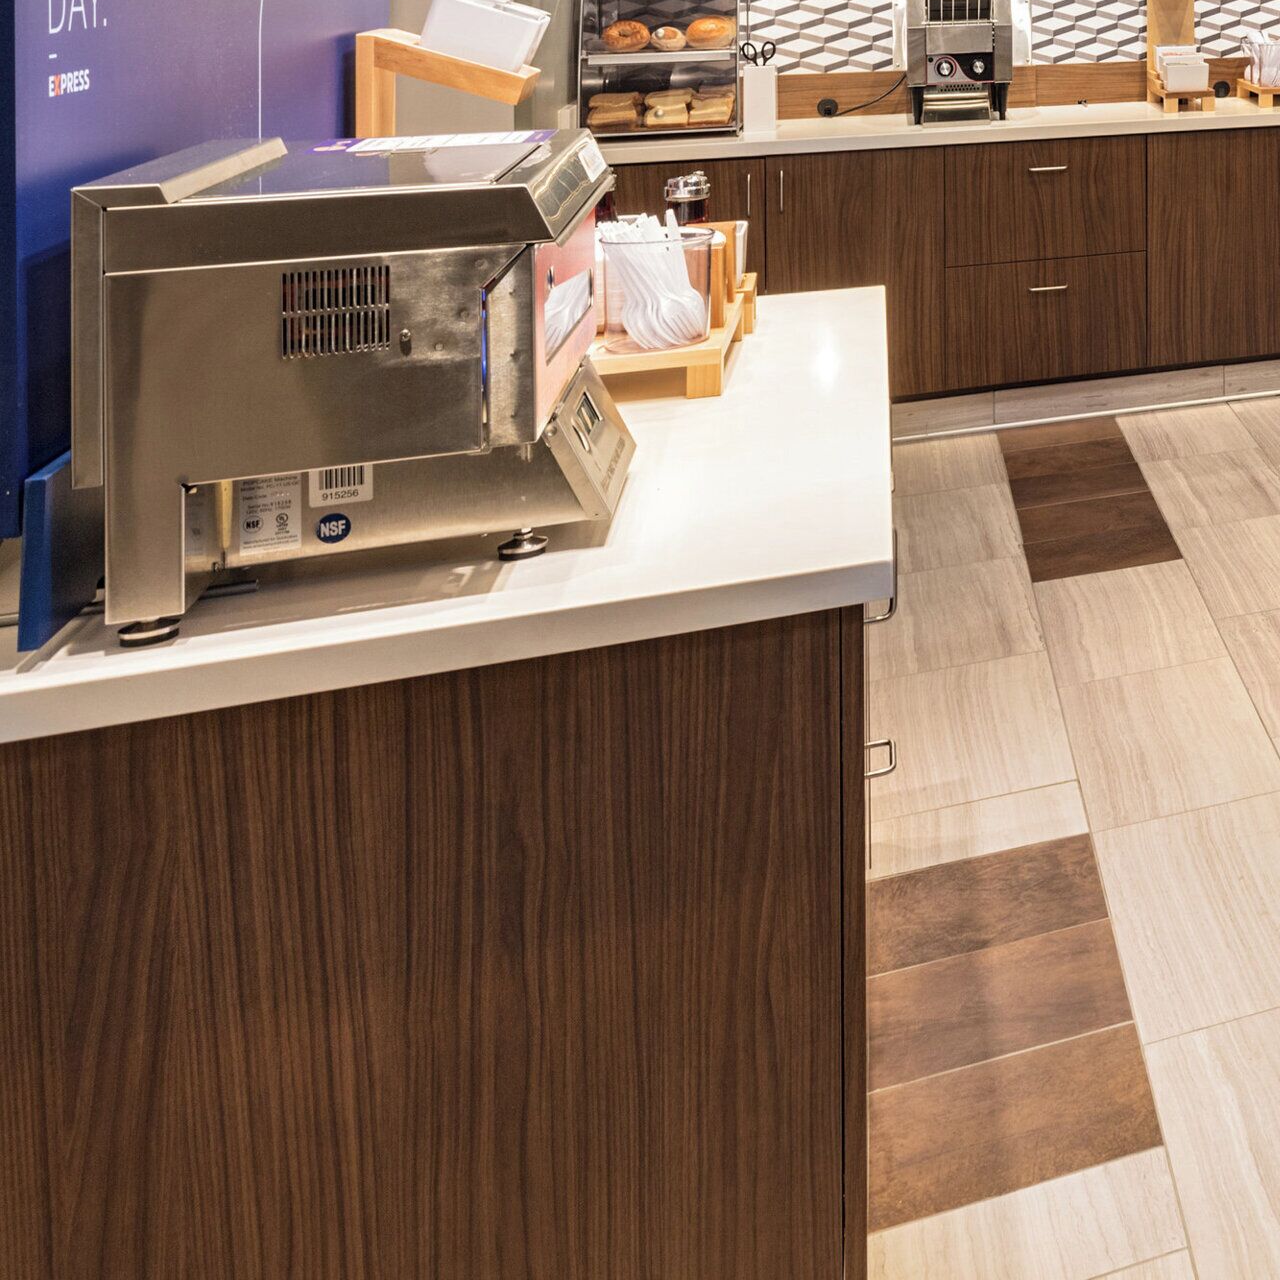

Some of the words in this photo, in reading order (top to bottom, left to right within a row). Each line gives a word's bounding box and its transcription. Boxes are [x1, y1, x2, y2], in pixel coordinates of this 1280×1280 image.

[48, 68, 91, 98] EXPRESS
[321, 489, 360, 502] 915256
[245, 519, 261, 531] NSF
[320, 519, 347, 538] NSF
